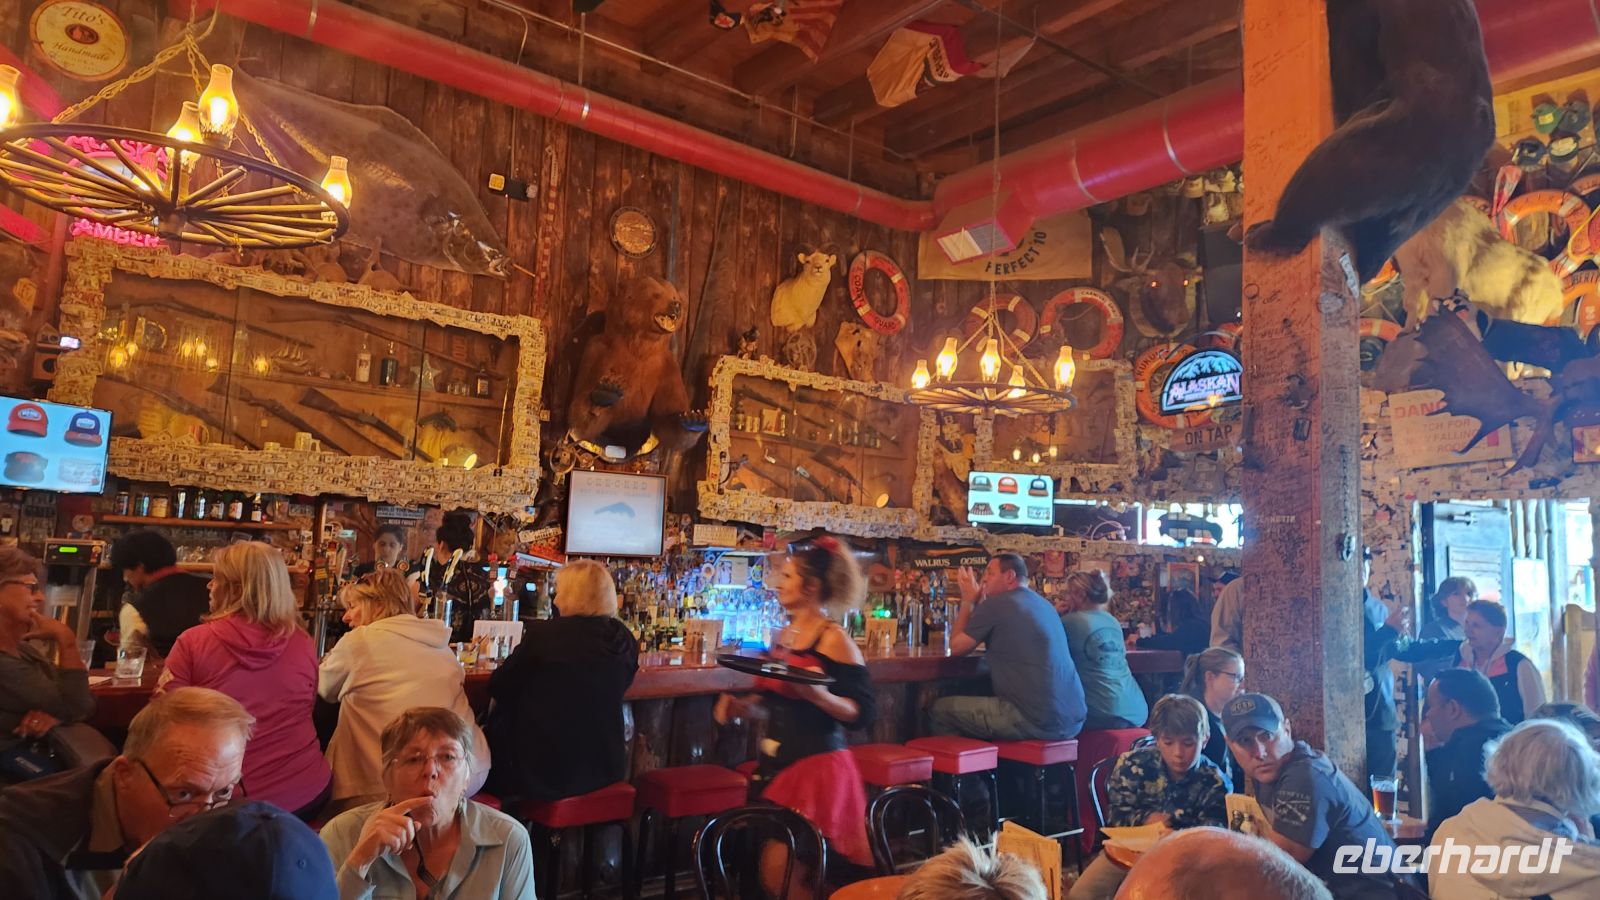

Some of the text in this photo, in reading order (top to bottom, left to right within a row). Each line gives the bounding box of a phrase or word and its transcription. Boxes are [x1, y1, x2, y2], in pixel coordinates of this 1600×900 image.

[61, 6, 104, 25] Tito's
[54, 41, 110, 61] Handmade
[71, 218, 161, 249] AMBER
[984, 230, 1047, 275] PERFECT 10
[1167, 372, 1241, 405] ALASKAN
[1185, 424, 1233, 446] ON TAP
[914, 556, 988, 568] WALRUS OOSIK
